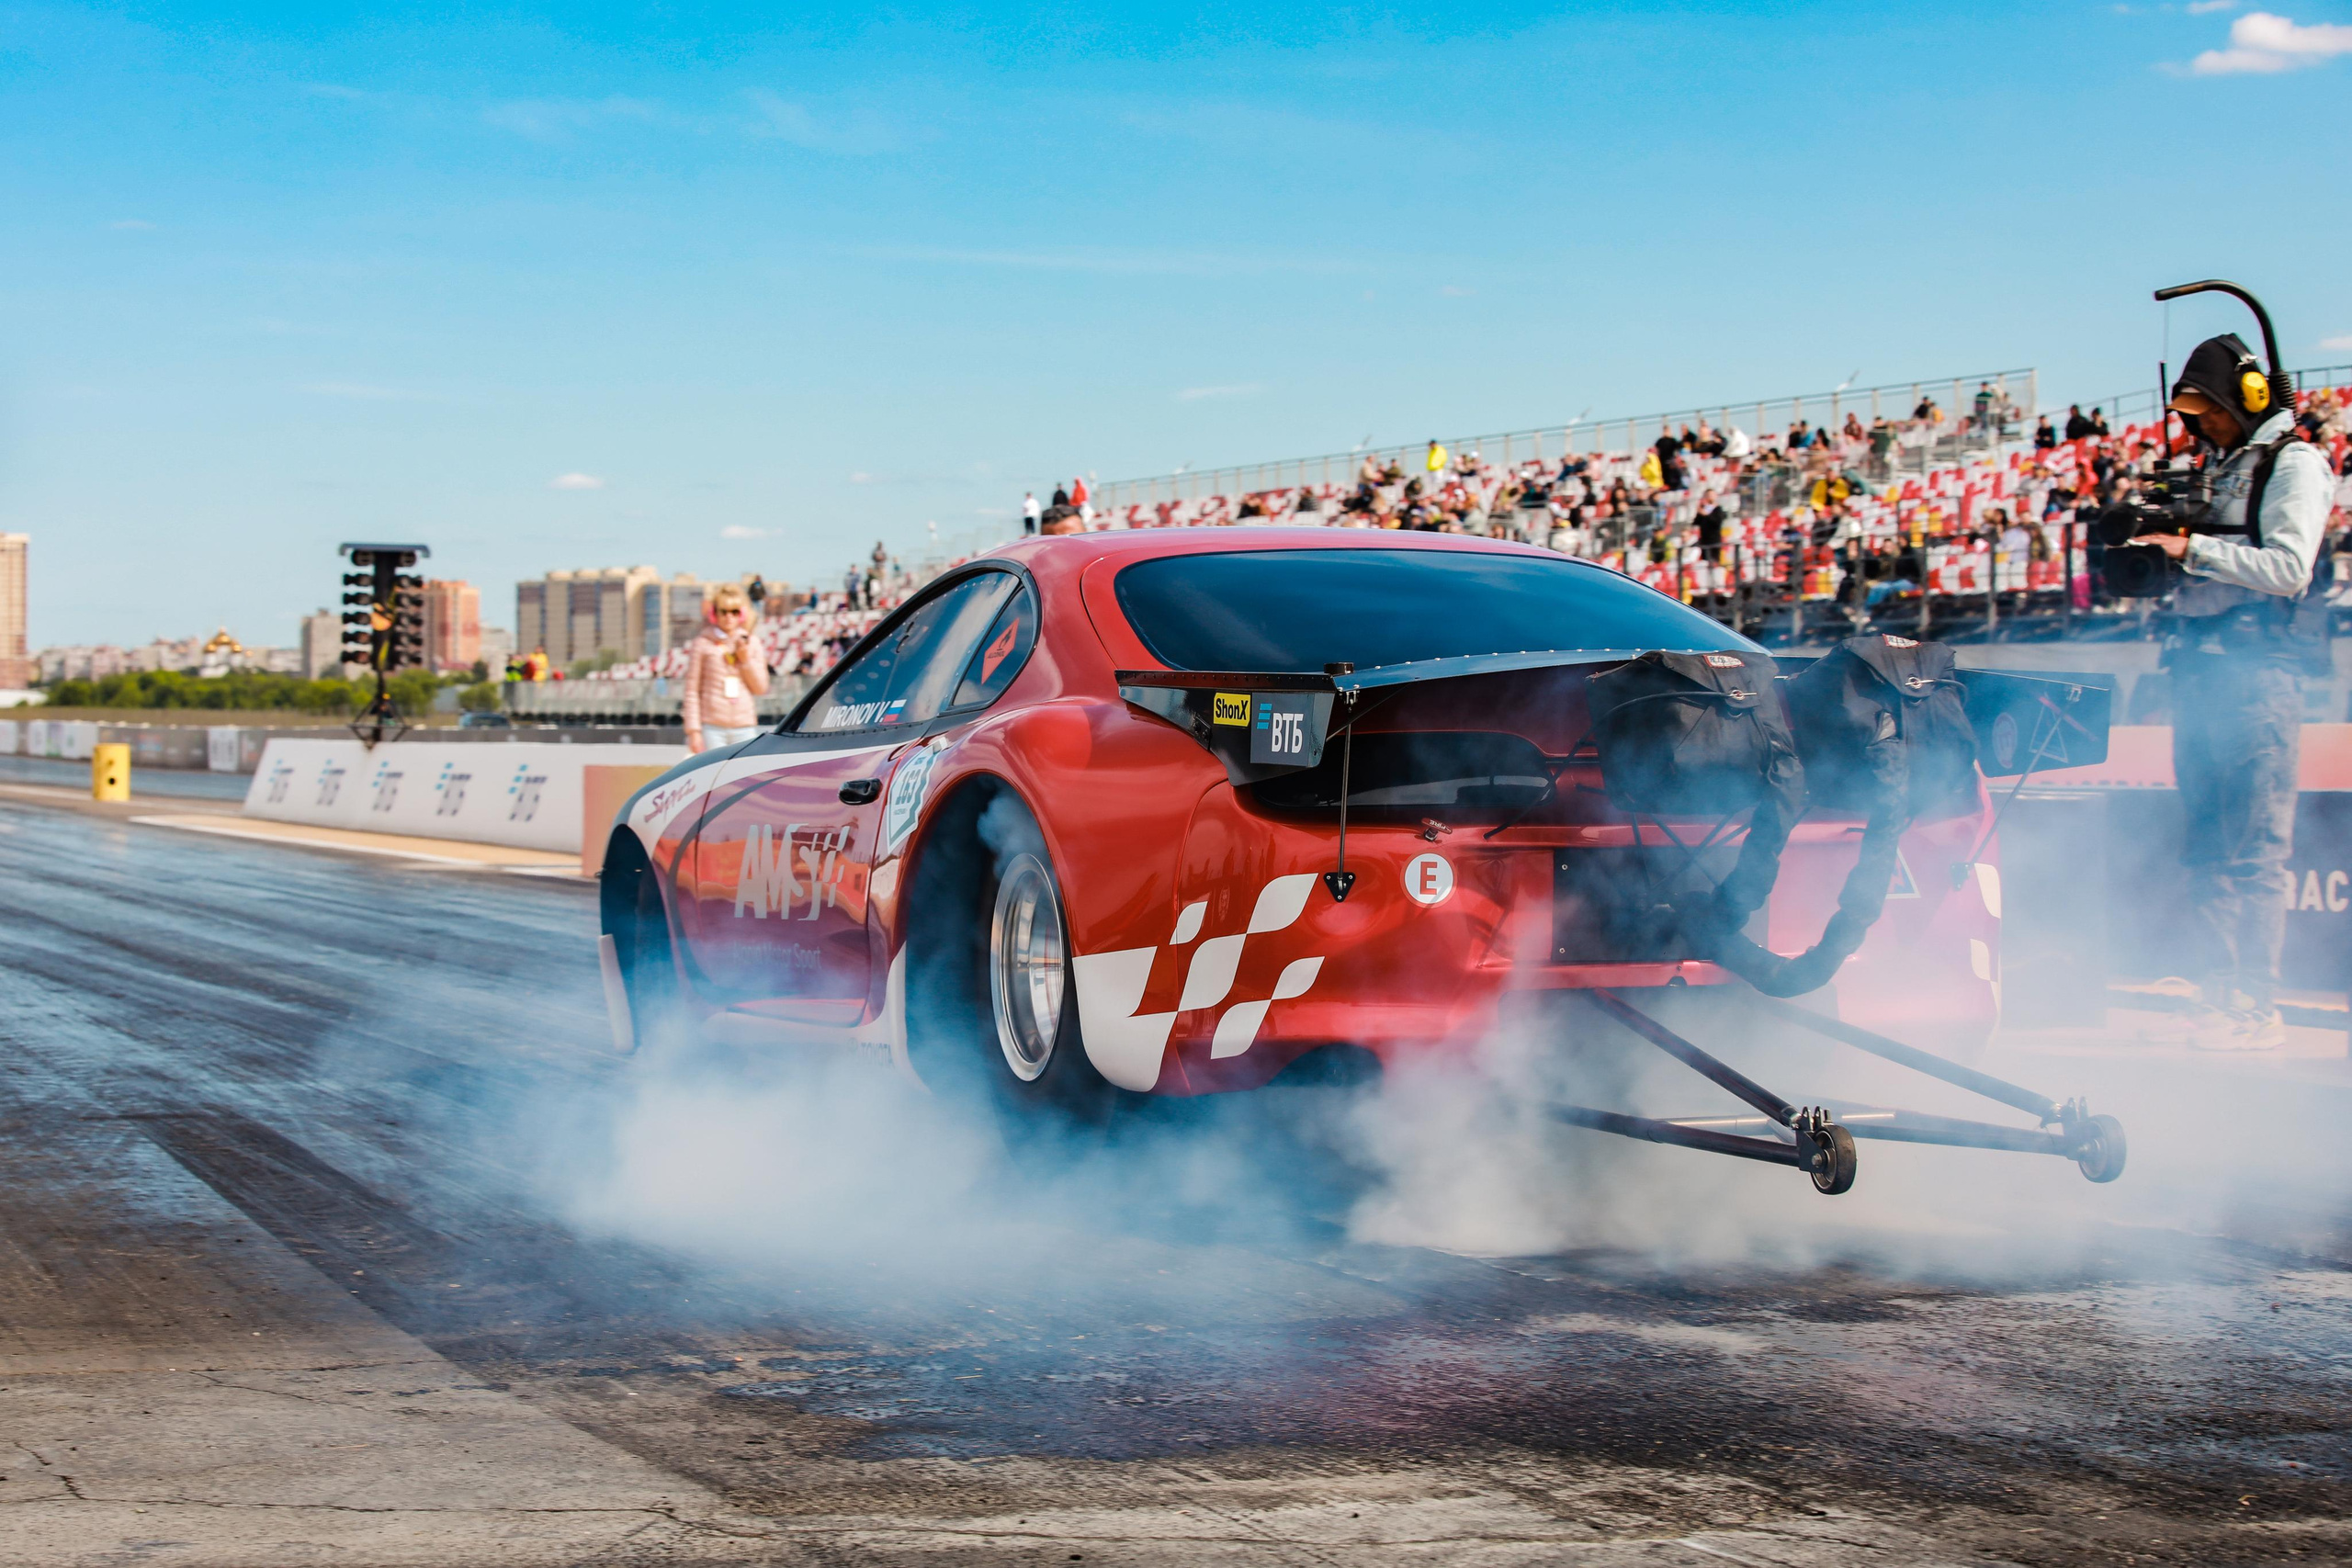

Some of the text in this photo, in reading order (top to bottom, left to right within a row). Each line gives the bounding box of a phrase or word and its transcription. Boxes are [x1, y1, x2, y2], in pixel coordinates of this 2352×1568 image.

[820, 701, 891, 728] MIRONOV V.
[1216, 698, 1248, 720] ShonX
[1271, 712, 1304, 754] ВТБ
[1419, 861, 1438, 896] E
